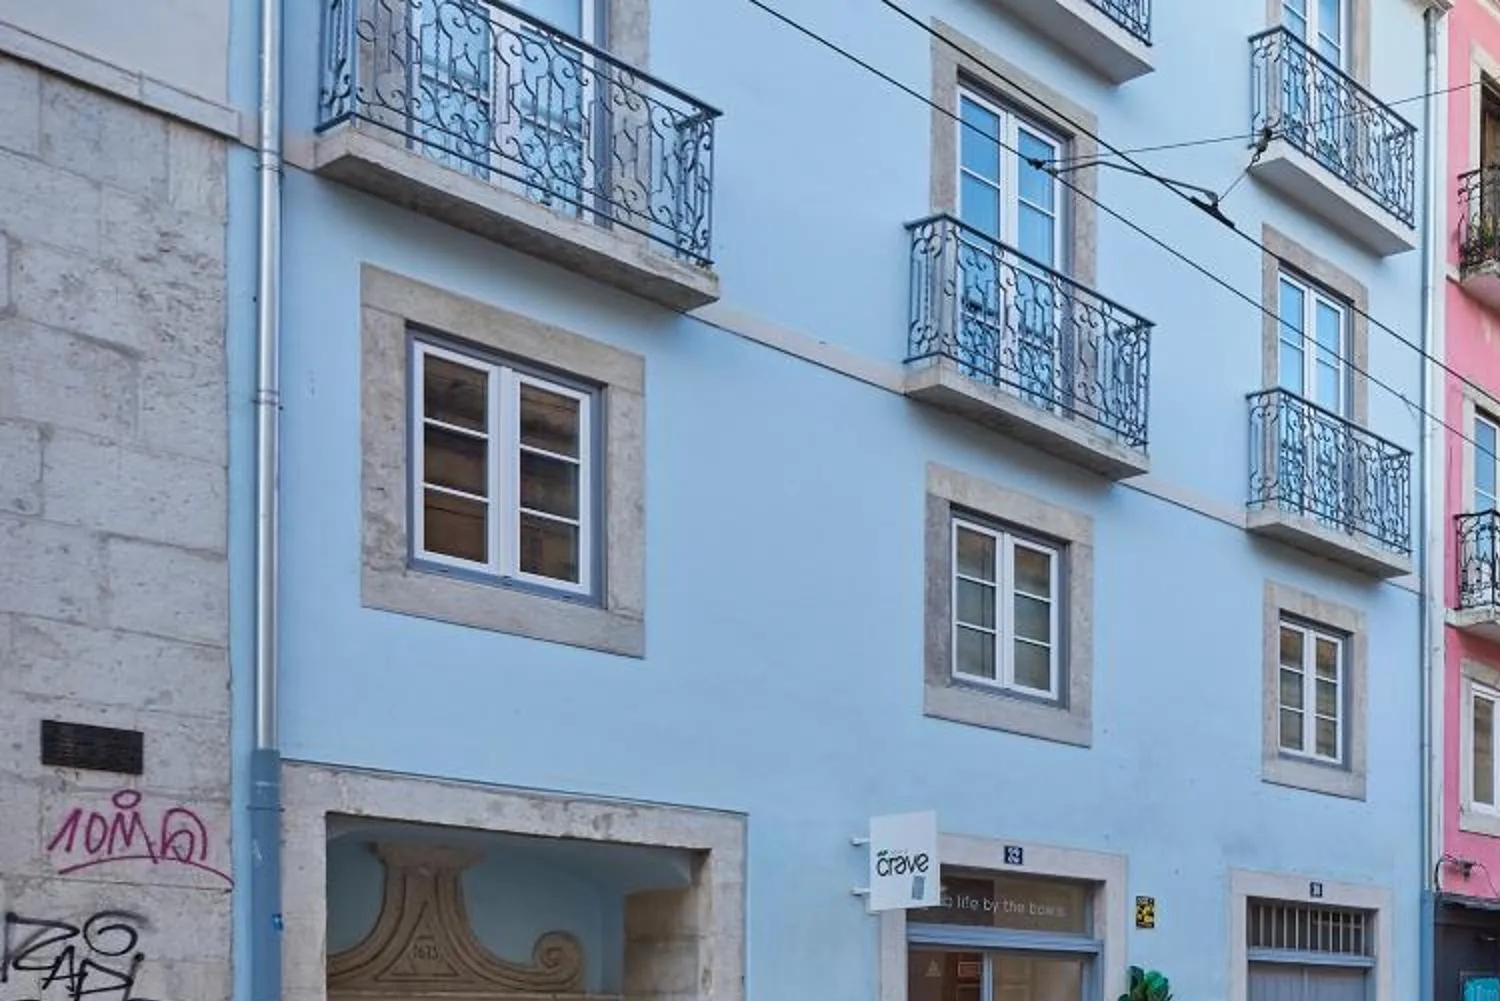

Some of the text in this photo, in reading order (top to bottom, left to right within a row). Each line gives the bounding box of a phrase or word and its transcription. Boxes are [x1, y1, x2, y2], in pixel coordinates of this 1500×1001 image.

[876, 852, 929, 877] crave
[983, 896, 999, 915] by
[1003, 899, 1025, 913] the
